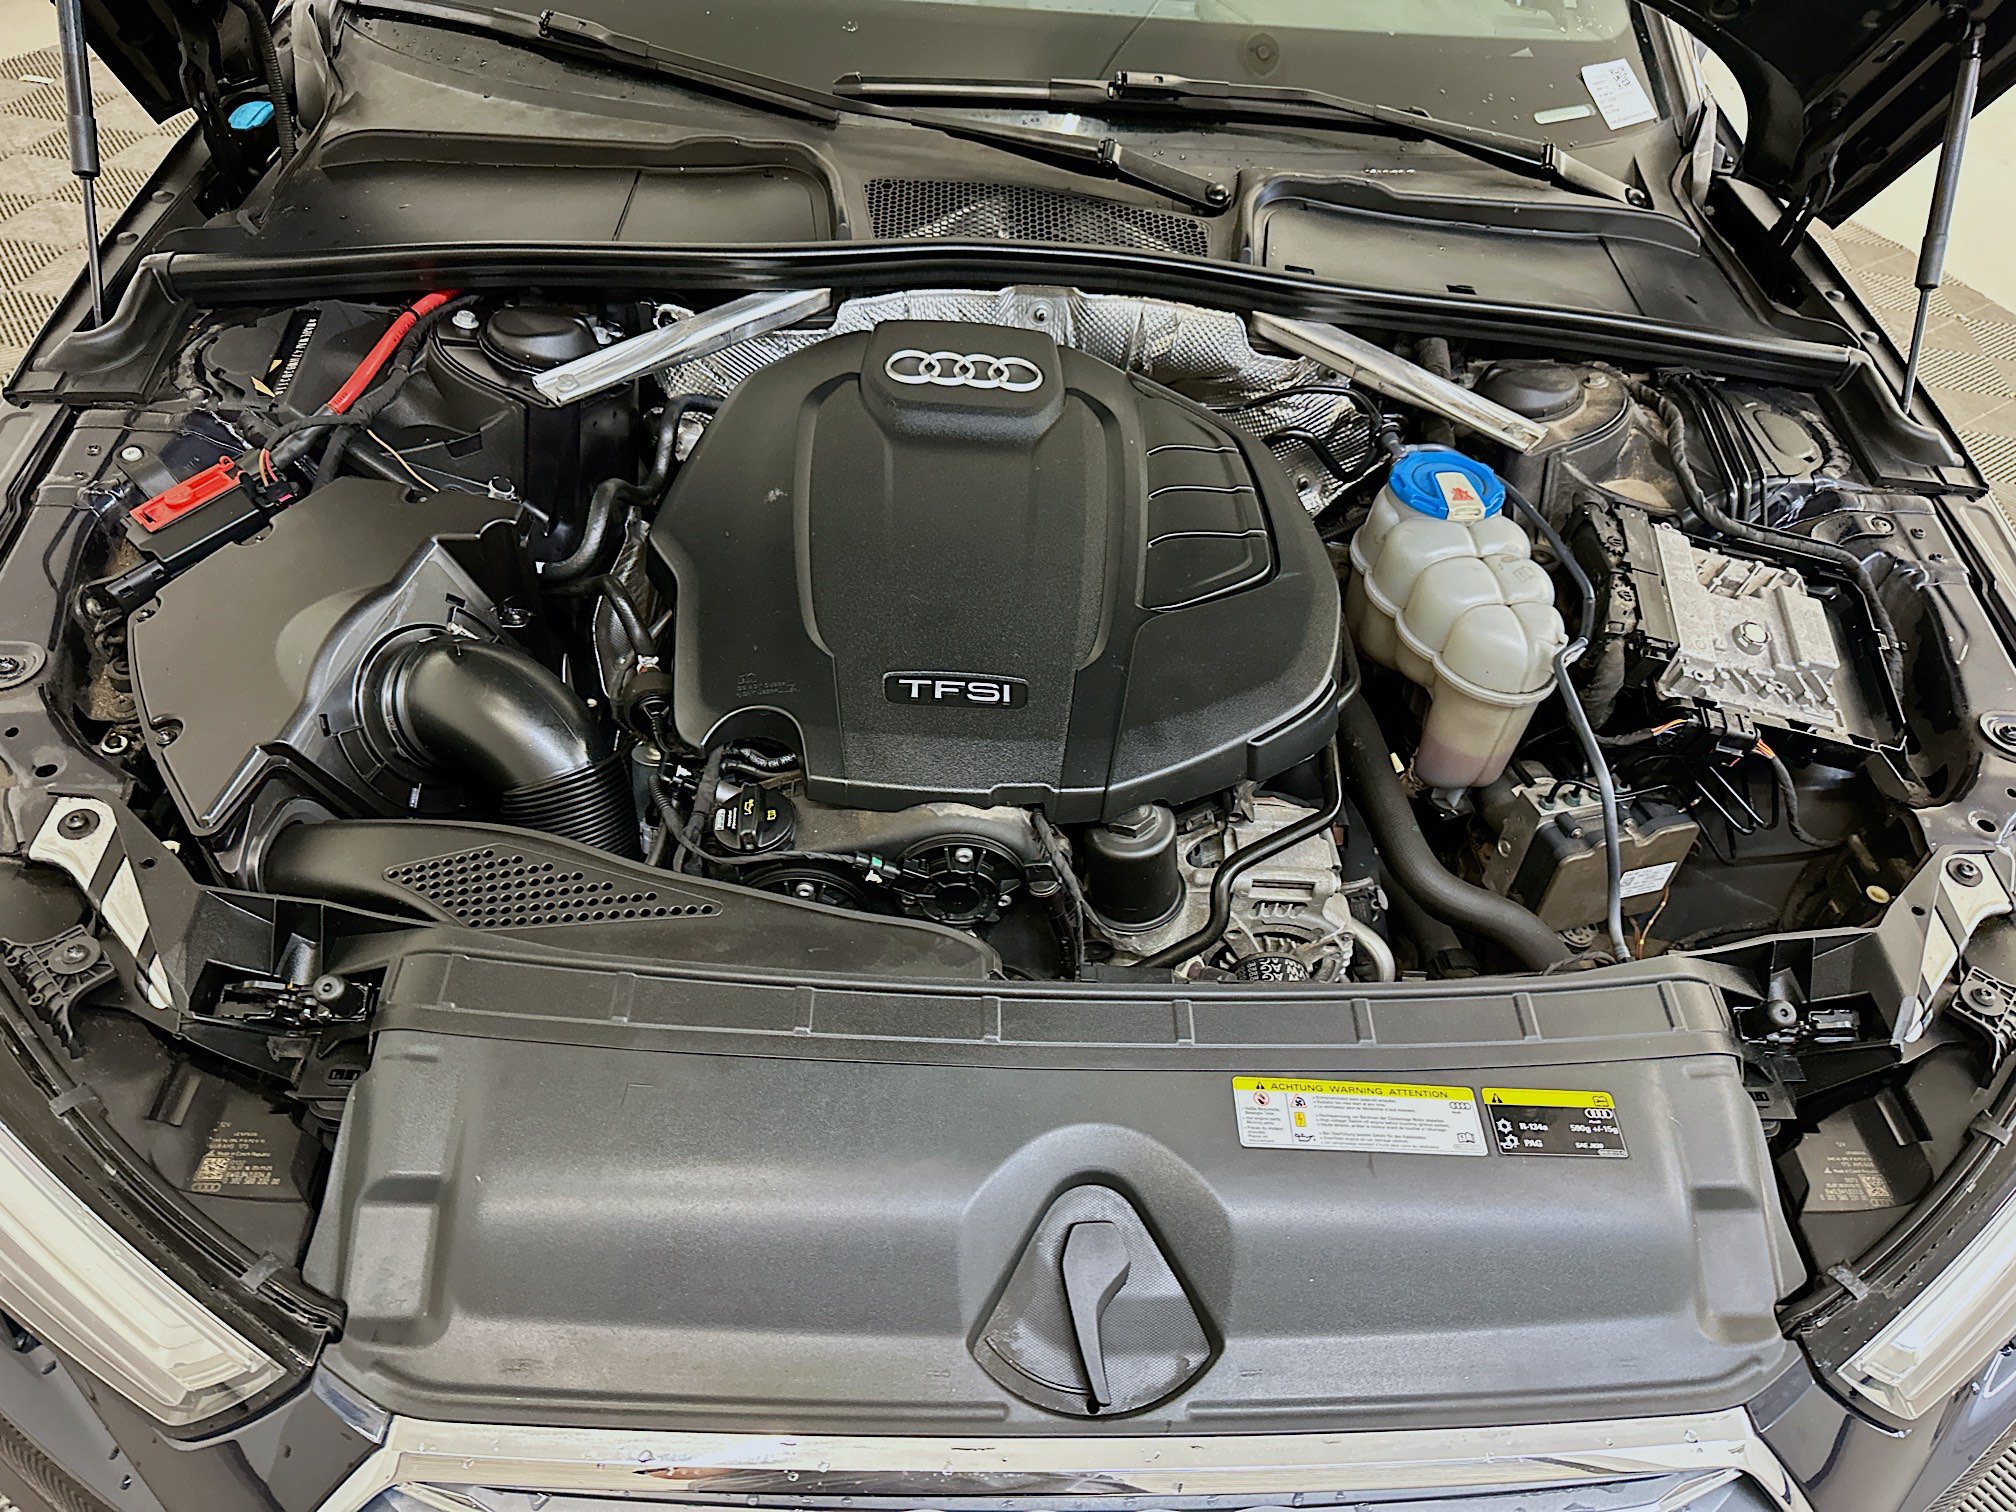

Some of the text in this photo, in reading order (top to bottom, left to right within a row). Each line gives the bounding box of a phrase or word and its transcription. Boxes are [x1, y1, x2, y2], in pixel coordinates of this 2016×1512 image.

[898, 679, 1011, 703] TFSI
[1270, 1083, 1448, 1098] ACHTUNG WARNING ATTENTION
[1524, 1139, 1544, 1148] PAG
